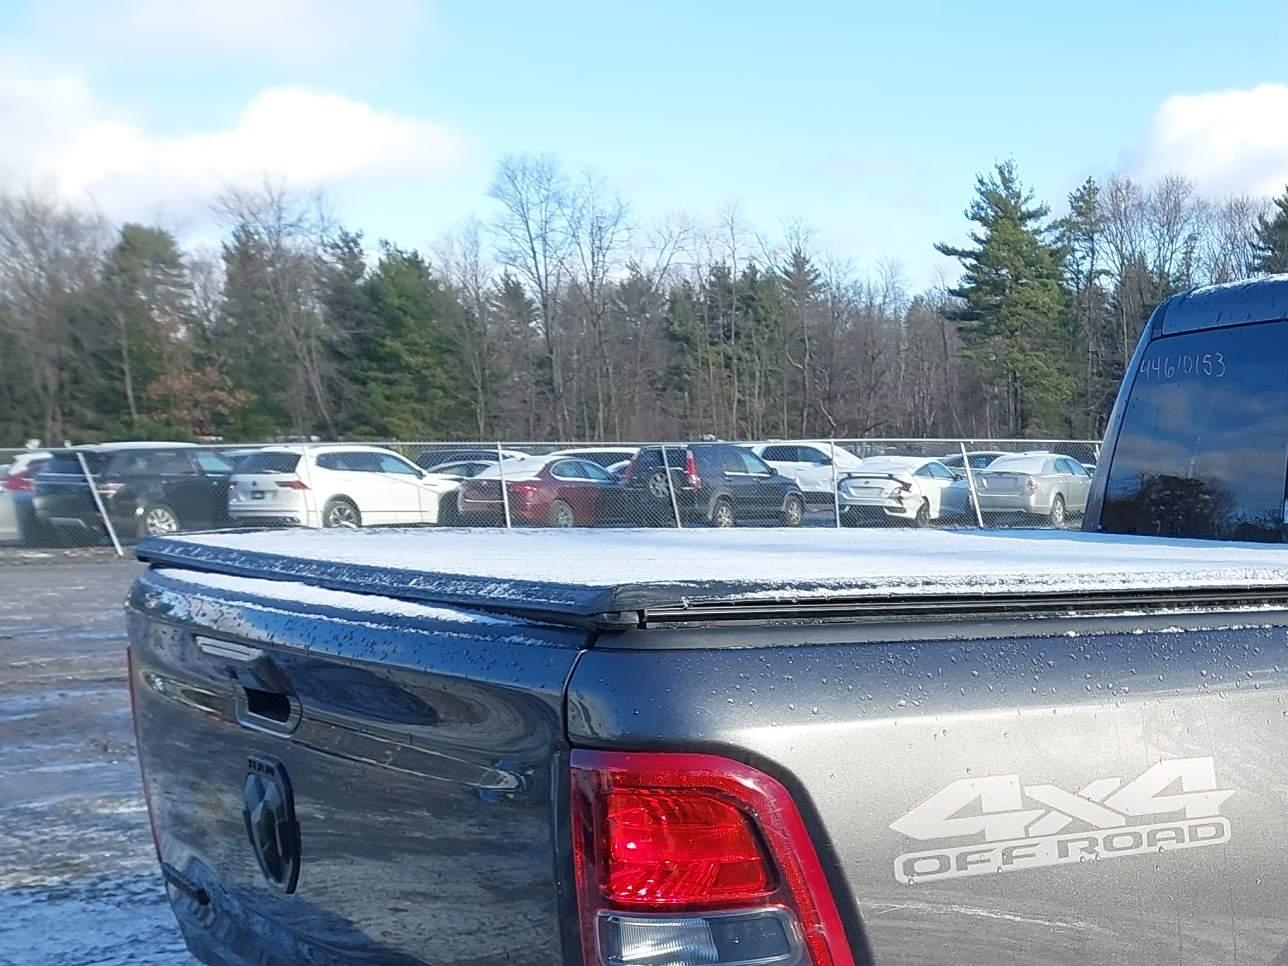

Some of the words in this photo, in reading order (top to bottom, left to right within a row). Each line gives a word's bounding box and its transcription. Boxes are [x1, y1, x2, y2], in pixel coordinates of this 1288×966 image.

[1140, 352, 1227, 381] 44610153
[902, 843, 1041, 877] OFF
[1057, 823, 1226, 861] ROAD
